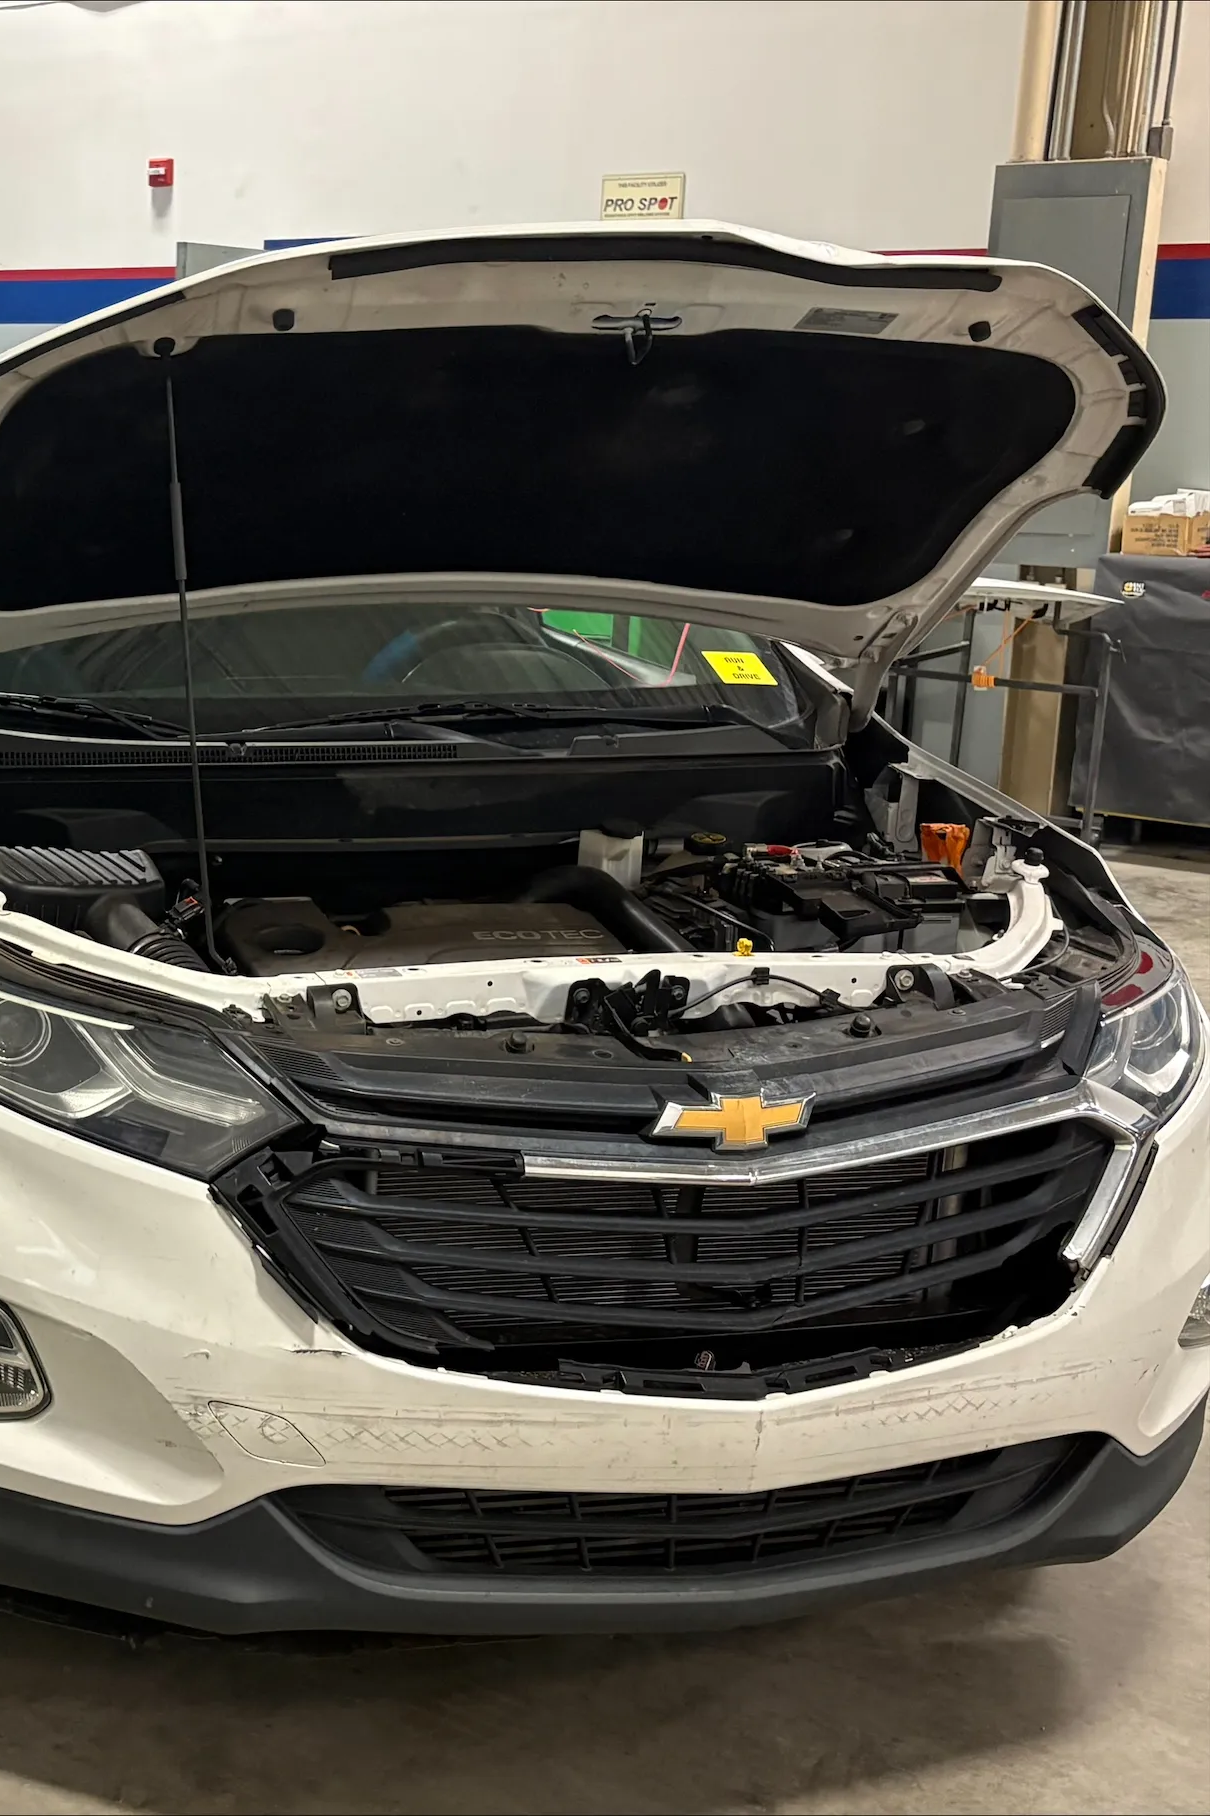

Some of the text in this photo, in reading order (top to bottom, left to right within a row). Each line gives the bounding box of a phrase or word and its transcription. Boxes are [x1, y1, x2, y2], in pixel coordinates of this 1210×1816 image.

[603, 196, 678, 212] PRO SPOT
[724, 656, 745, 664] RUN
[732, 672, 761, 680] DRIVE
[472, 929, 604, 940] ECOTEC
